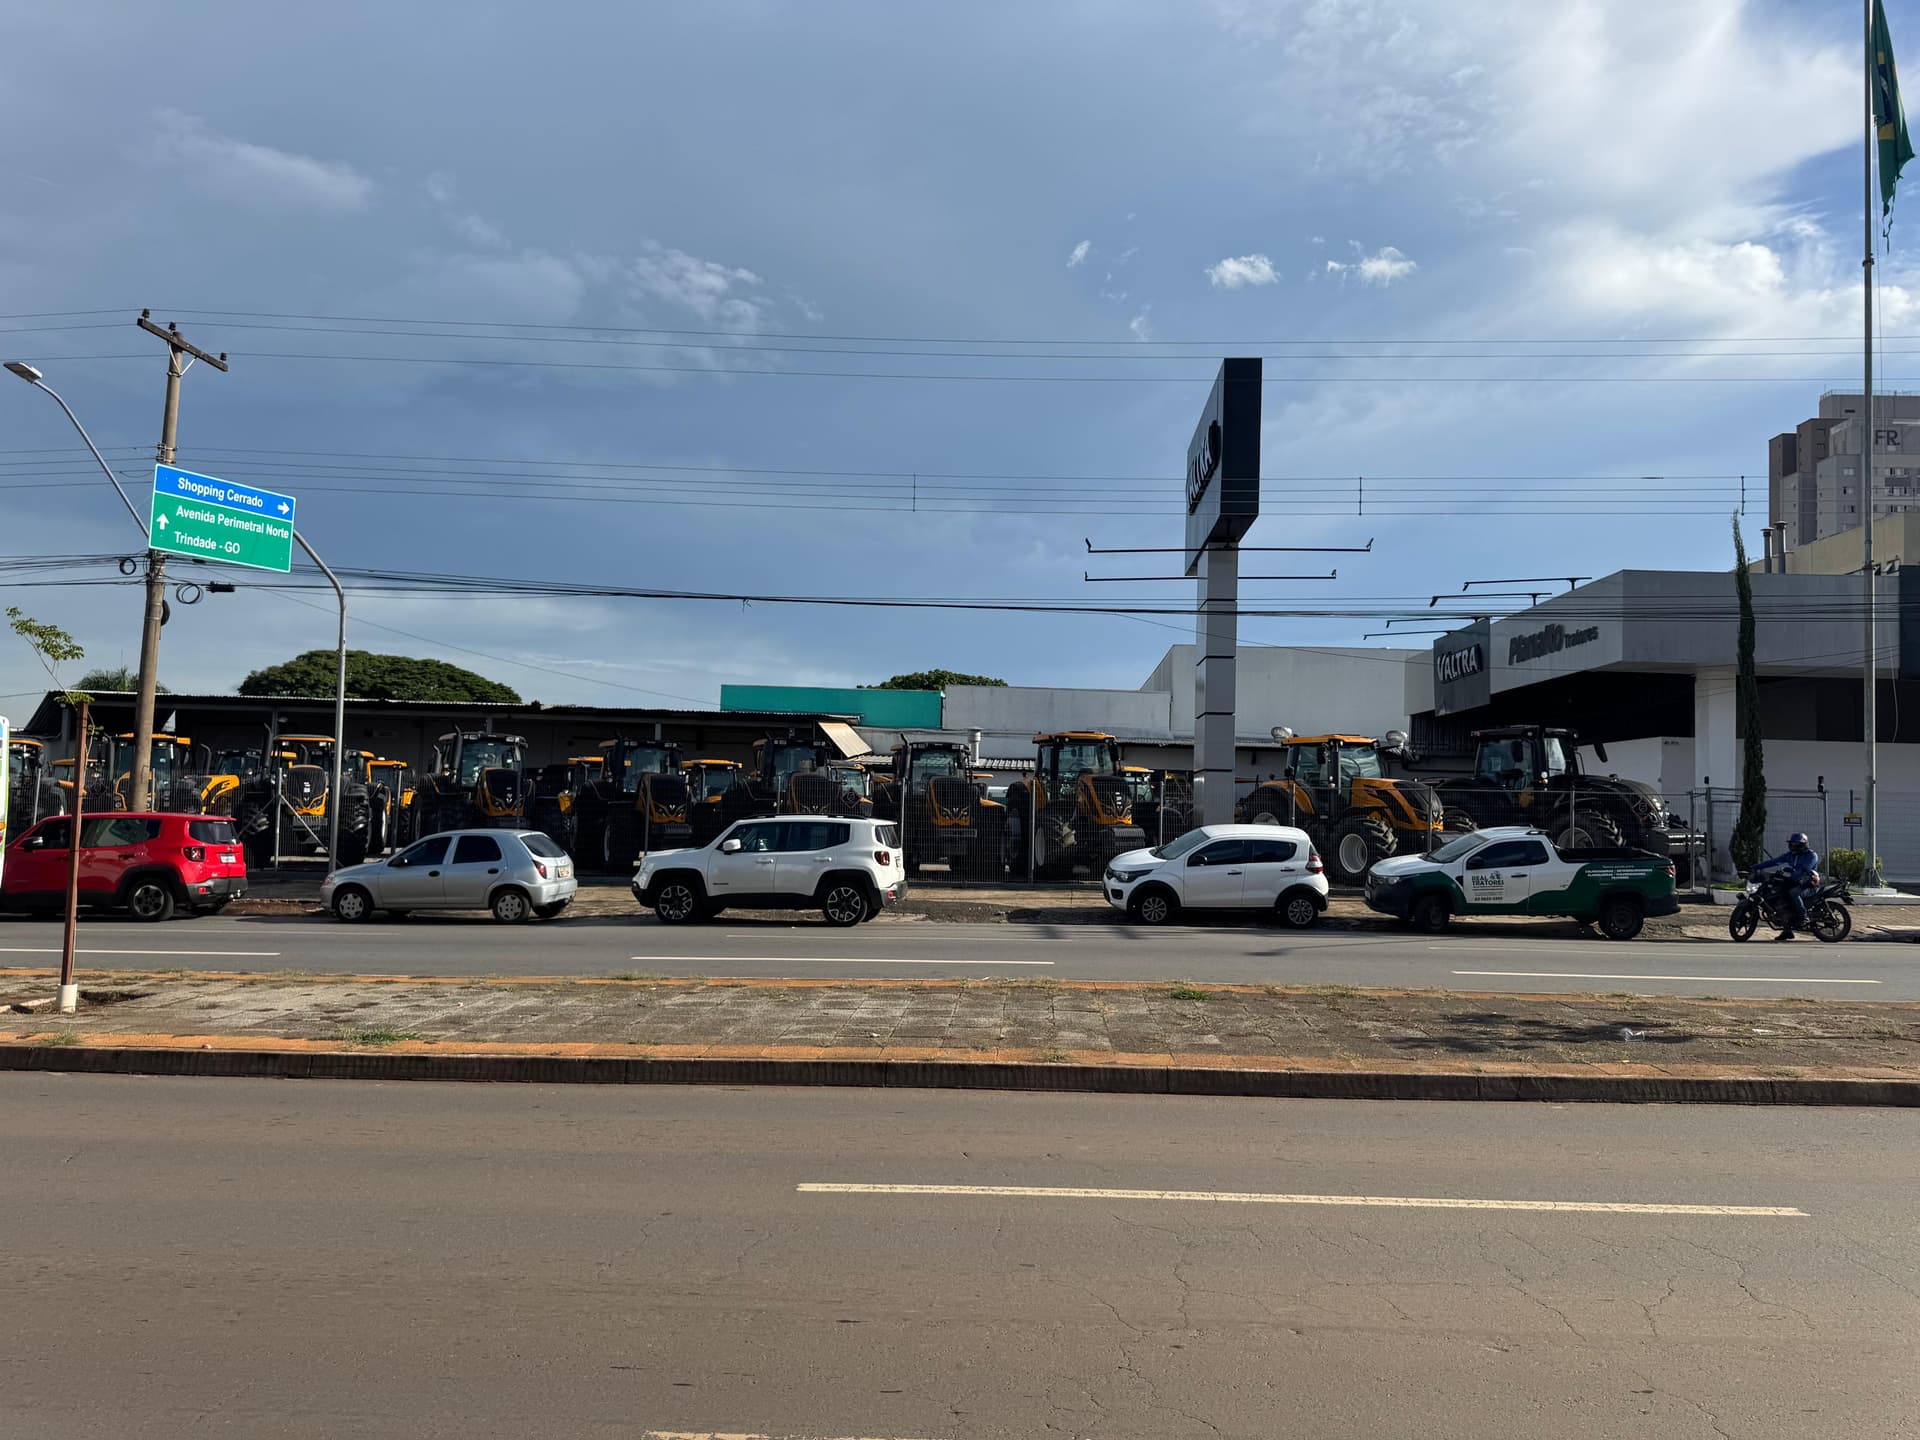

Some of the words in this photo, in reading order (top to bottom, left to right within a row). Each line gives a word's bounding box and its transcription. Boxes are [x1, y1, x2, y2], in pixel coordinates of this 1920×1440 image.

[177, 477, 225, 501] Shopping
[226, 489, 263, 508] Cerrado
[176, 505, 215, 524] Avenida
[217, 513, 264, 533] Perimetral
[265, 524, 289, 539] Norte
[174, 531, 217, 550] Trindade
[224, 541, 240, 554] GO
[1437, 646, 1478, 681] VALTRA
